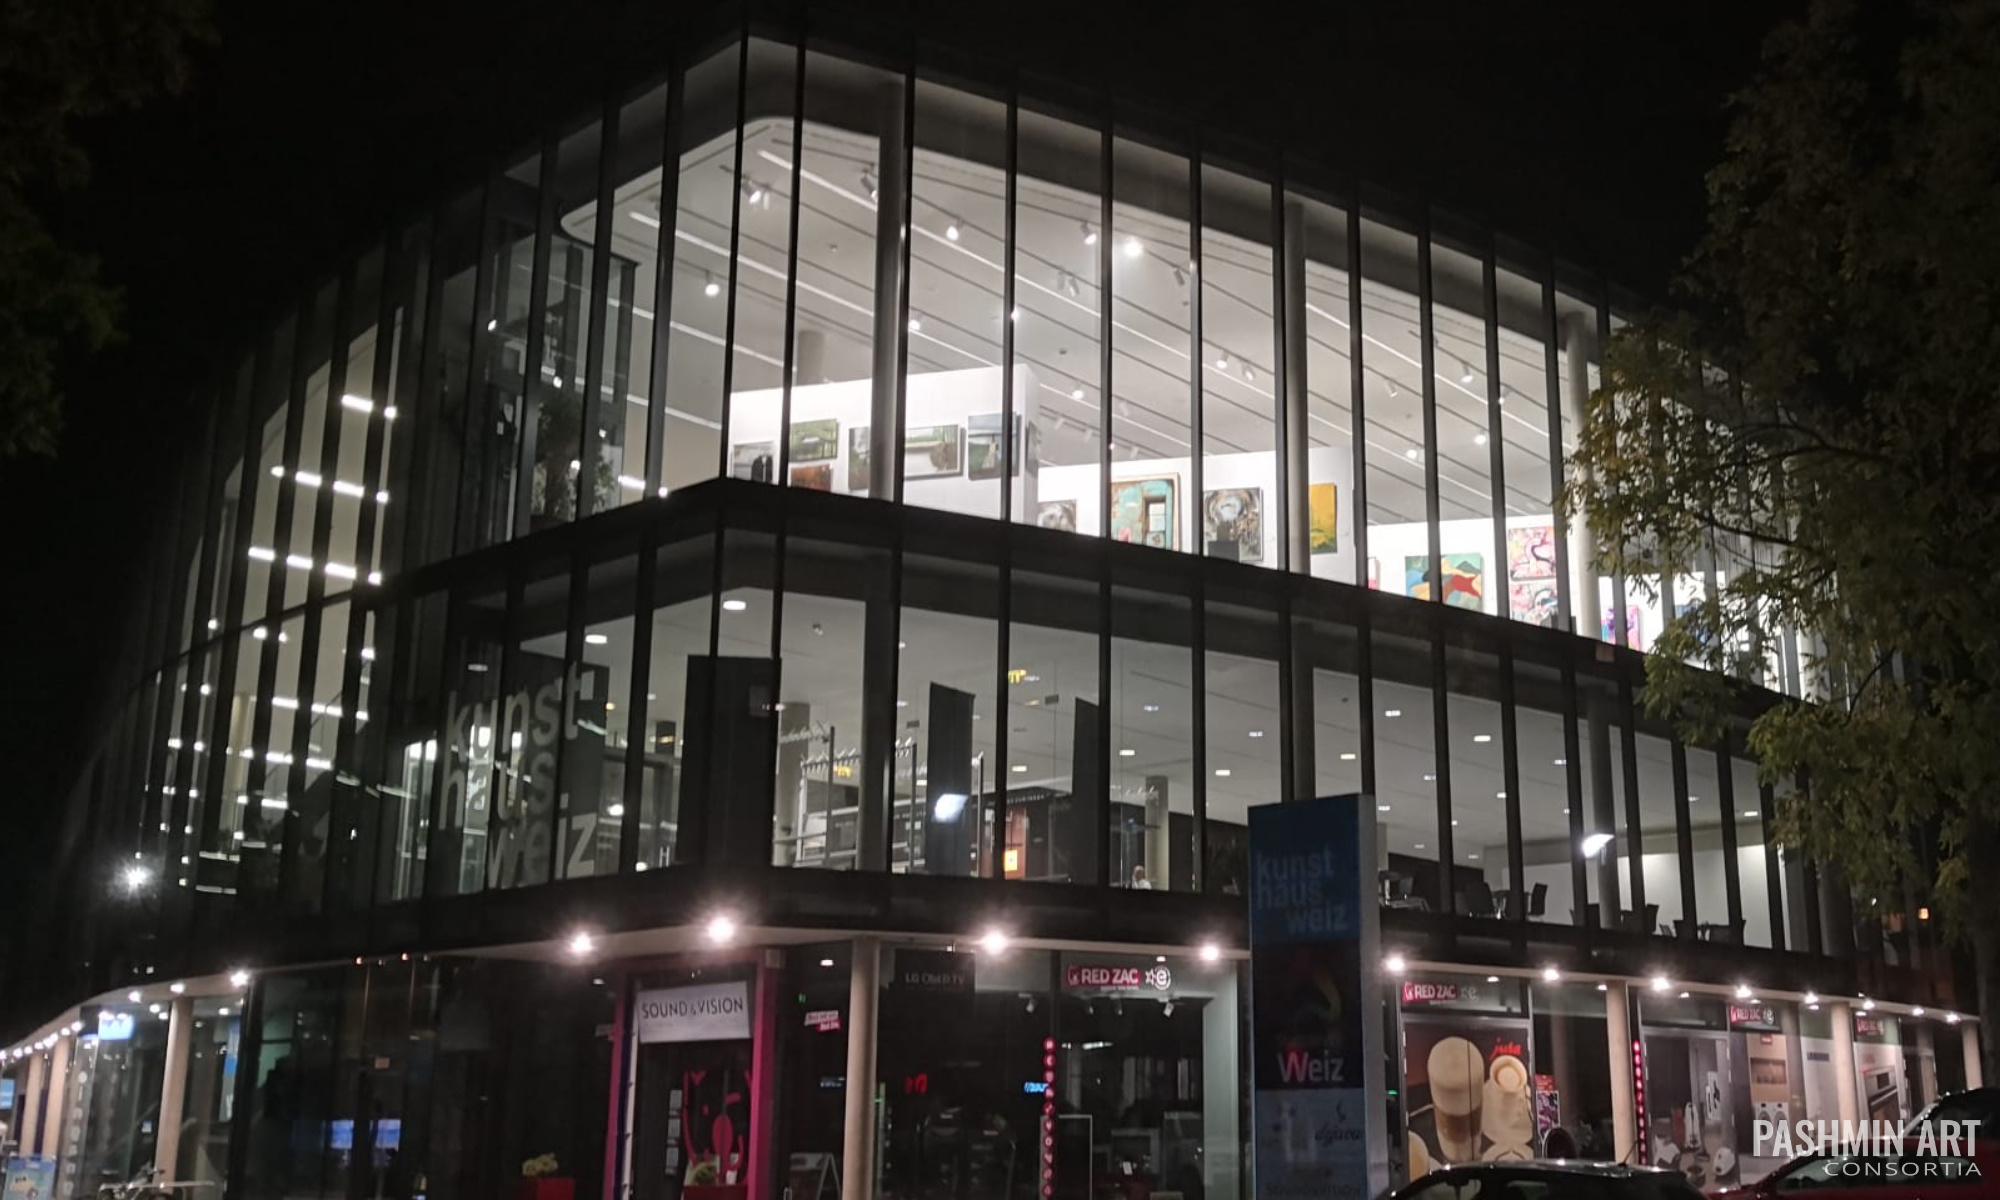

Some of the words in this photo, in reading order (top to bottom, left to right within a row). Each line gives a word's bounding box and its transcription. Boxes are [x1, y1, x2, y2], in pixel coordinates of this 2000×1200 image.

[444, 662, 581, 763] kunst
[438, 748, 556, 831] haus
[487, 792, 597, 889] weiz
[1257, 844, 1334, 881] kunst
[1257, 878, 1323, 911] haus
[1286, 901, 1347, 934] weiz
[1081, 968, 1110, 985] RED
[1112, 968, 1139, 985] ZAC
[1414, 984, 1436, 999] RED
[1437, 984, 1457, 999] ZAC
[641, 1000, 688, 1019] SOUND
[698, 997, 743, 1015] VISION
[1277, 1050, 1344, 1083] Weiz
